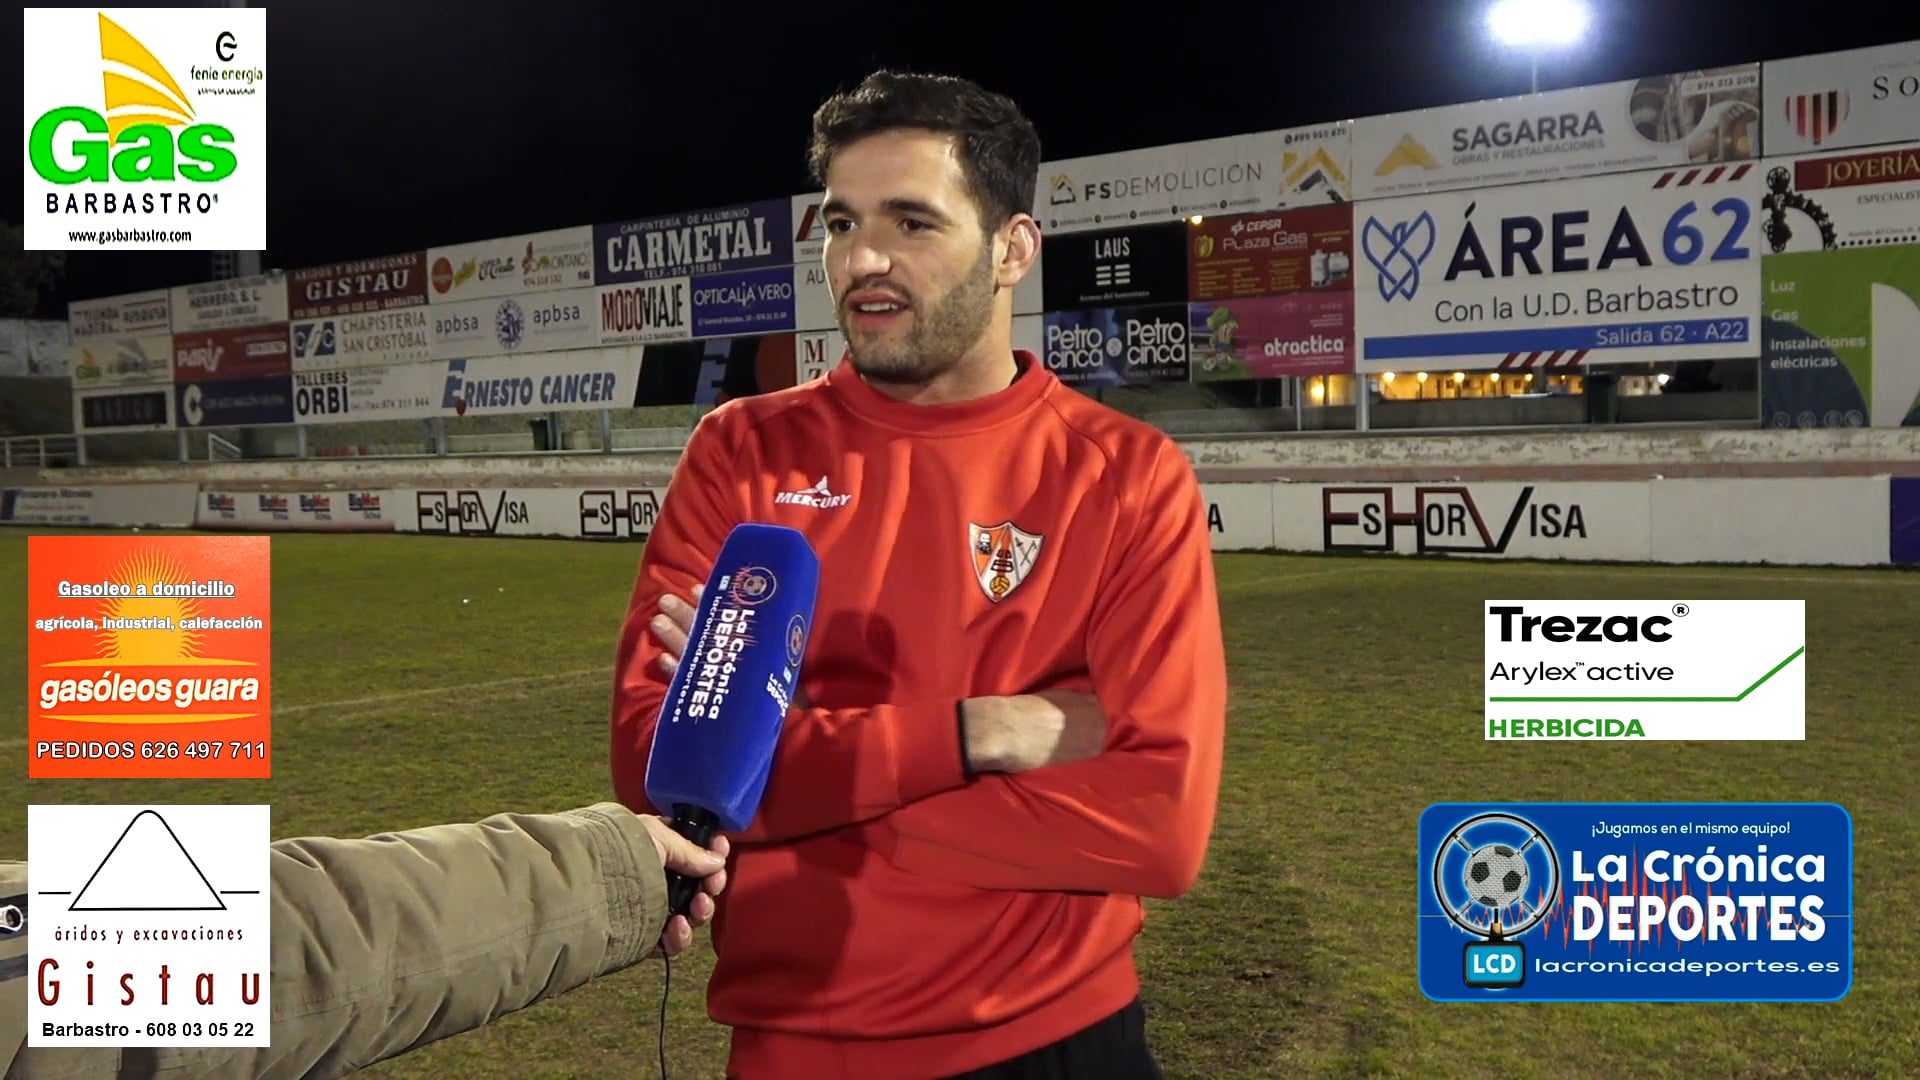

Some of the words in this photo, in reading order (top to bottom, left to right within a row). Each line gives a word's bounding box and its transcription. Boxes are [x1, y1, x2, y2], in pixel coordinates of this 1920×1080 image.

[1453, 110, 1604, 152] SAGARRA
[1452, 149, 1490, 165] OBRAS
[1492, 149, 1500, 161] Y
[1502, 138, 1604, 160] RESTAURACIONES
[1825, 151, 1920, 188] JOYERÍA
[687, 215, 700, 226] DE
[702, 208, 750, 223] ALUMINIO
[607, 216, 772, 272] CARMETAL
[1095, 236, 1130, 259] LAUS
[306, 269, 410, 300] GISTAU
[759, 282, 792, 300] VERO
[1771, 280, 1796, 293] Luz
[534, 304, 581, 328] apbsa
[602, 284, 684, 332] MODOVIAJE
[1434, 301, 1483, 324] Con
[1493, 296, 1513, 320] la
[1523, 292, 1578, 318] U.D.
[1586, 284, 1739, 314] Barbastro
[1772, 309, 1799, 322] Gas
[436, 314, 479, 336] apbsa
[1048, 323, 1103, 351] Petro
[1126, 317, 1186, 346] Petro
[1596, 326, 1654, 346] Salida
[1660, 324, 1686, 344] 62
[1704, 321, 1744, 340] A22
[344, 338, 365, 354] SAN
[804, 338, 826, 364] M
[1127, 344, 1186, 365] cinca
[1264, 334, 1345, 357] atractica
[1771, 336, 1867, 351] Instalaciones
[1048, 348, 1103, 369] cinca
[1771, 355, 1838, 369] eléctricas
[296, 370, 348, 386] TALLERES
[442, 360, 534, 408] ERNESTO
[540, 372, 616, 404] CANCER
[296, 386, 348, 416] ORBI
[775, 492, 852, 509] MERCURY
[738, 608, 755, 634] La
[672, 595, 722, 724] lacronicadeportes.es
[688, 608, 738, 718] DEPORTES
[708, 636, 744, 720] Crónica
